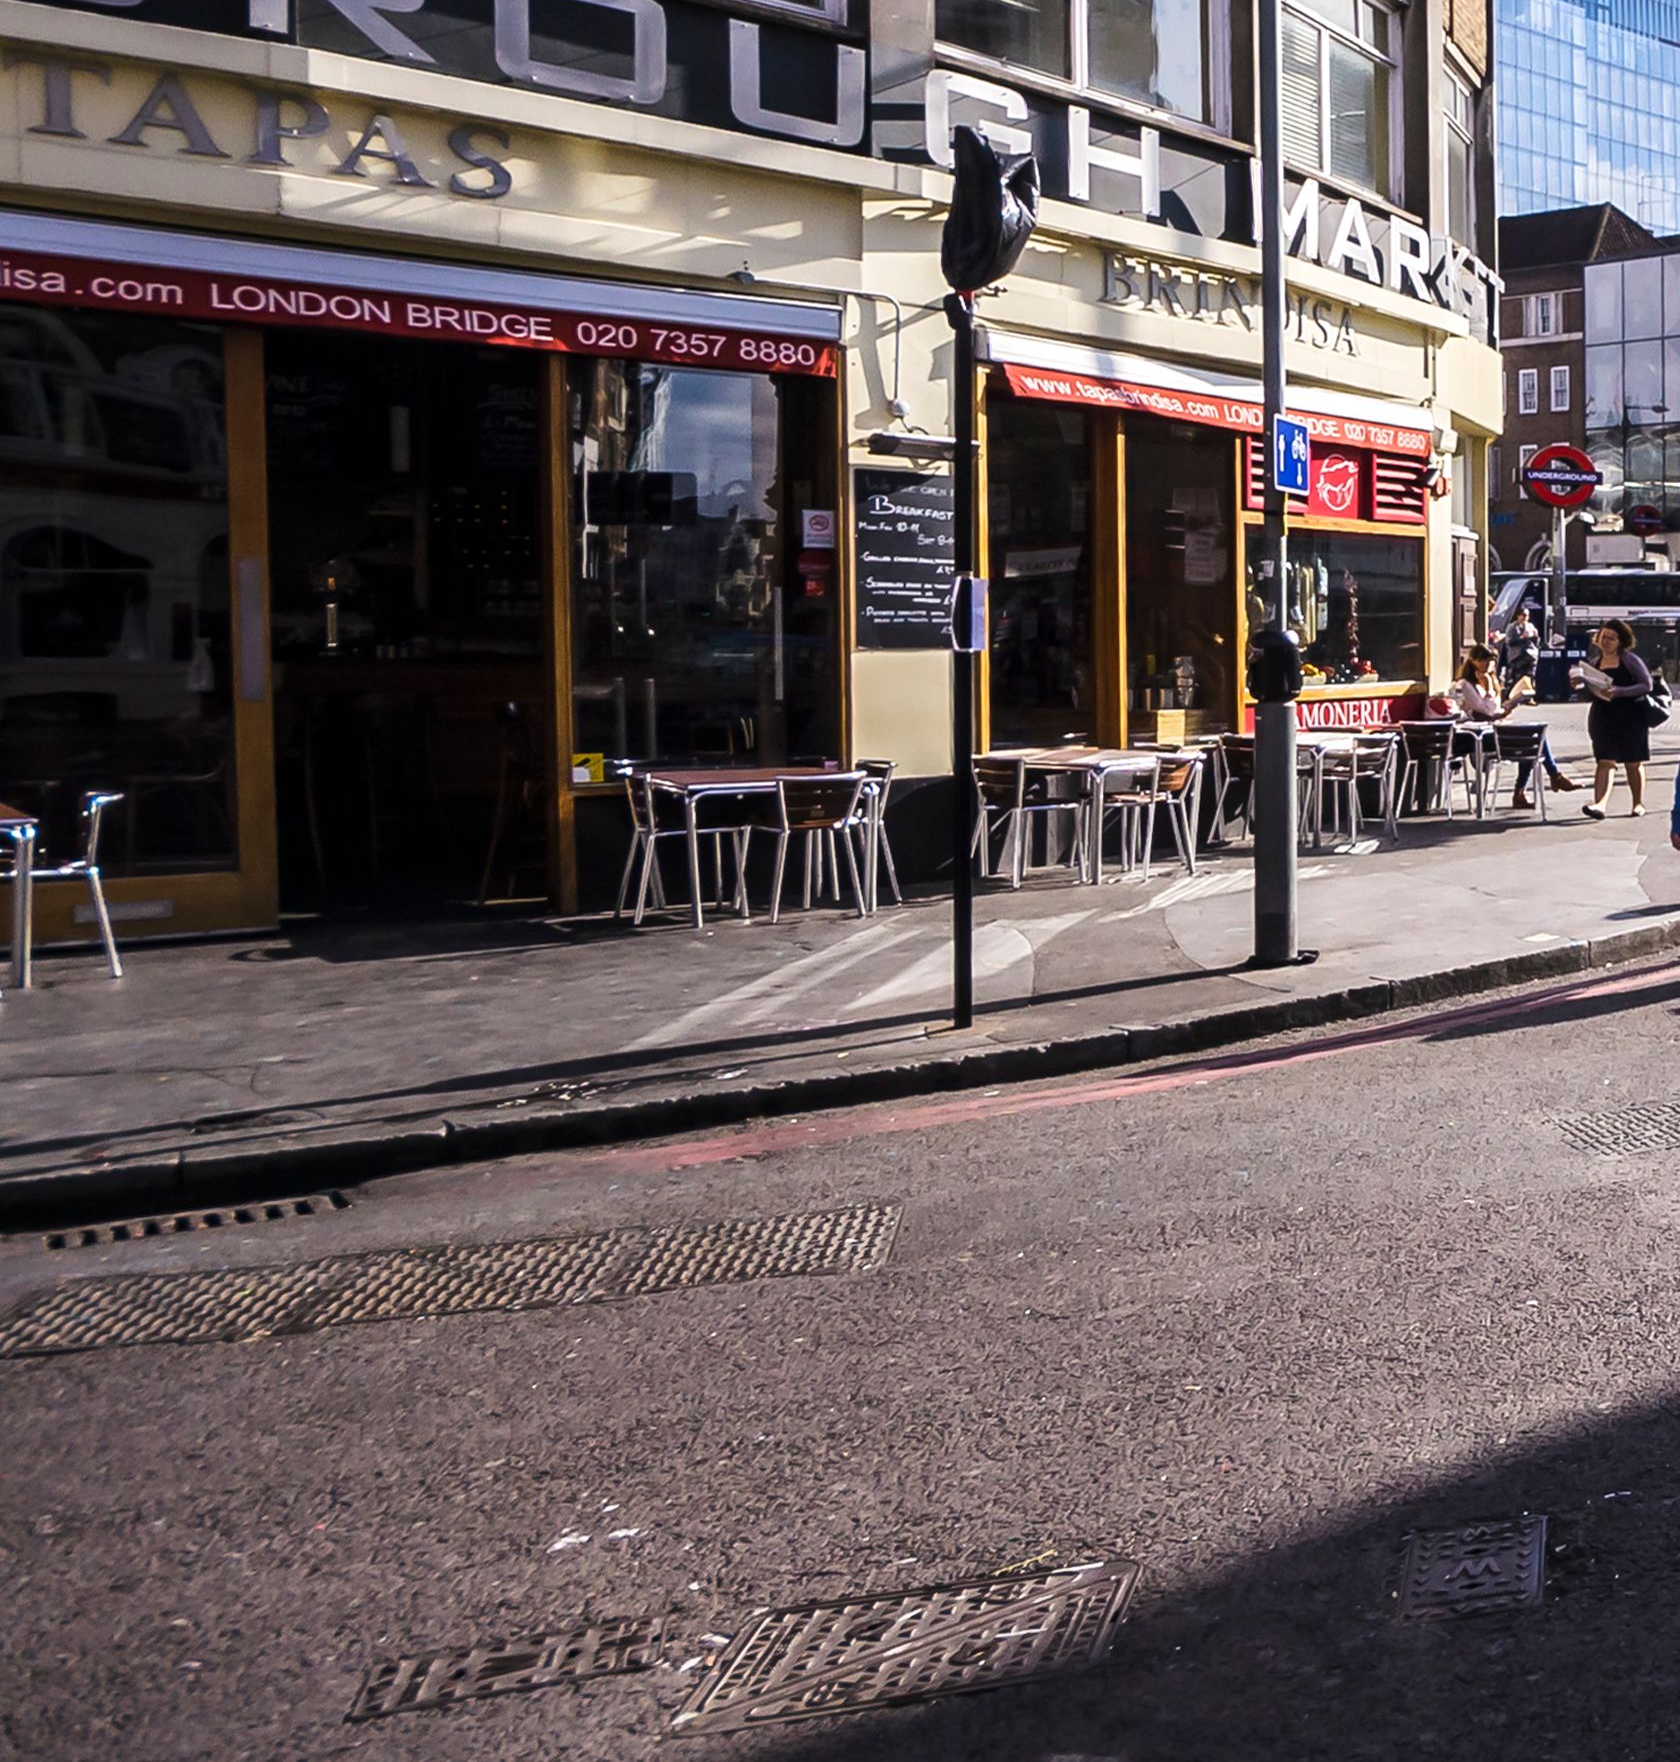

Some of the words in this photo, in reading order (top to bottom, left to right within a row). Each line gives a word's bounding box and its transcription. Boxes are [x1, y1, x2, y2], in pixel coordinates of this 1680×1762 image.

[3, 55, 513, 200] TAPAS
[210, 282, 392, 325] LONDON
[406, 302, 554, 341] BRIDGE
[576, 321, 638, 349] 020
[649, 328, 727, 357] 7357
[738, 338, 816, 366] 8880
[1224, 404, 1264, 427] LOND
[1344, 423, 1366, 441] 020
[1368, 426, 1394, 445] 7357
[1397, 431, 1426, 450] 8880
[1527, 471, 1598, 483] UNDERGROUND
